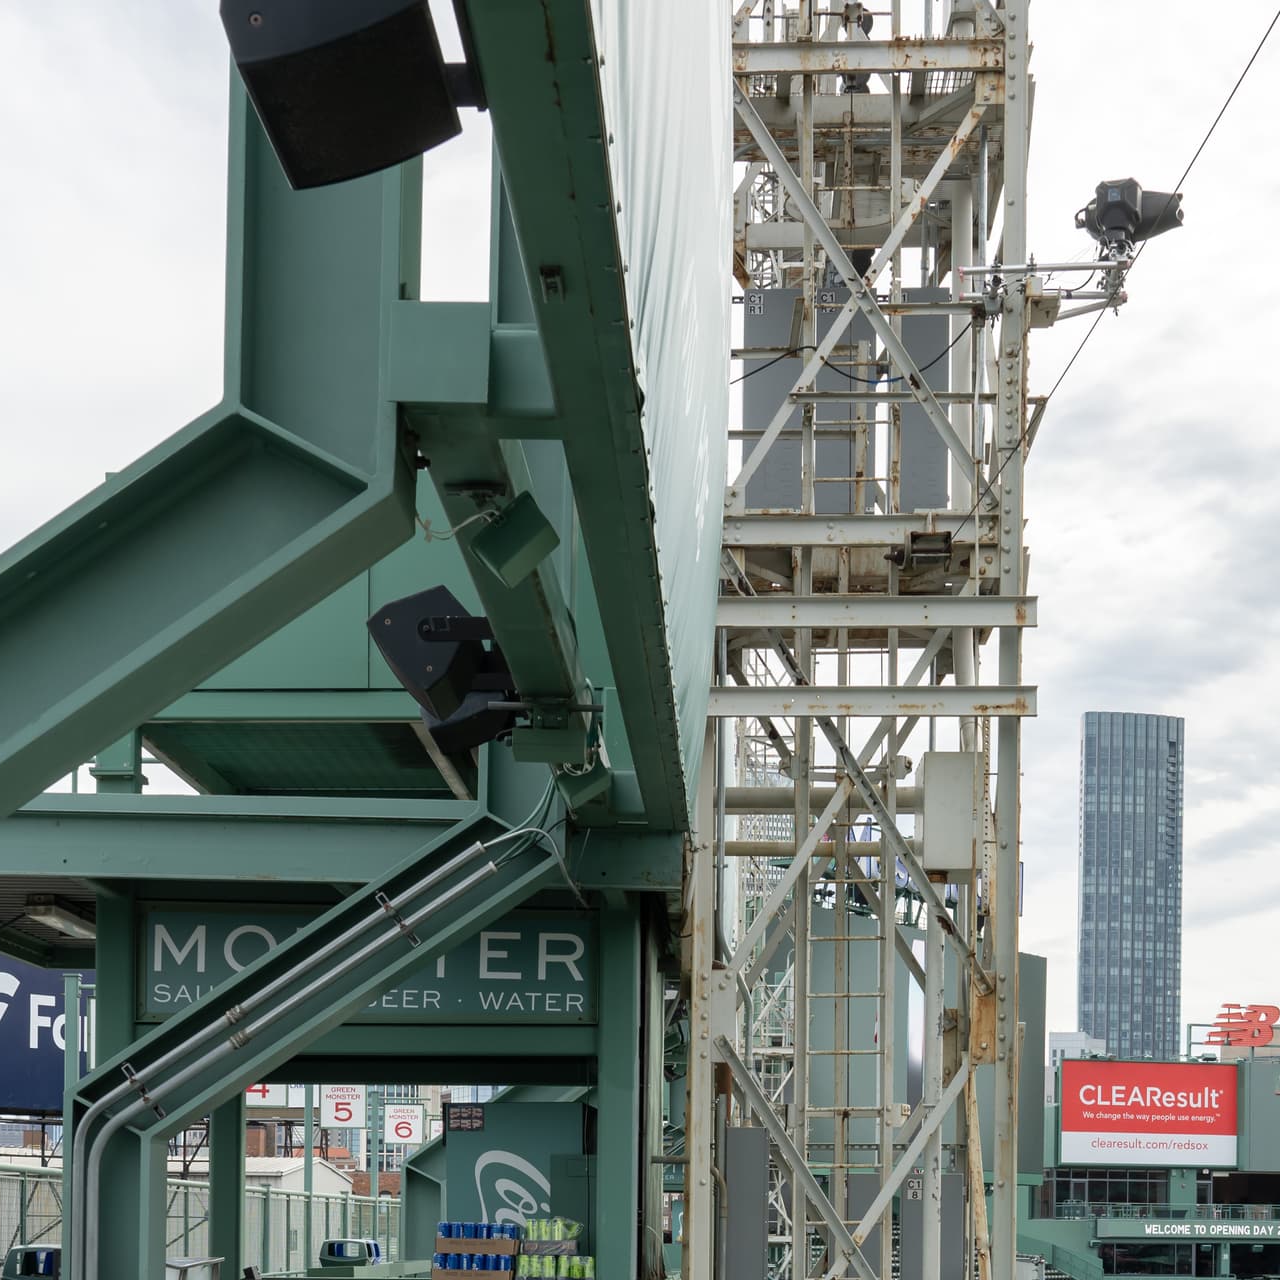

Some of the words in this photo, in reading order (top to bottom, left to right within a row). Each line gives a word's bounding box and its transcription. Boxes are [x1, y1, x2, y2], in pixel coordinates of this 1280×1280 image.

[153, 923, 585, 982] MOER
[368, 989, 441, 1009] EER
[479, 991, 584, 1012] WATER
[1079, 1084, 1220, 1109] CLEAResult
[333, 1101, 353, 1122] 5
[1082, 1111, 1094, 1119] We
[1095, 1111, 1122, 1121] change
[1123, 1112, 1135, 1120] the
[1136, 1113, 1150, 1122] way
[1151, 1112, 1176, 1122] people
[394, 1121, 413, 1139] 6
[1091, 1137, 1209, 1151] clearesult.com/redsox
[1145, 1224, 1190, 1235] WELCOME
[1194, 1224, 1207, 1235] TO
[1209, 1225, 1251, 1236] OPENING
[1253, 1225, 1274, 1236] DAY
